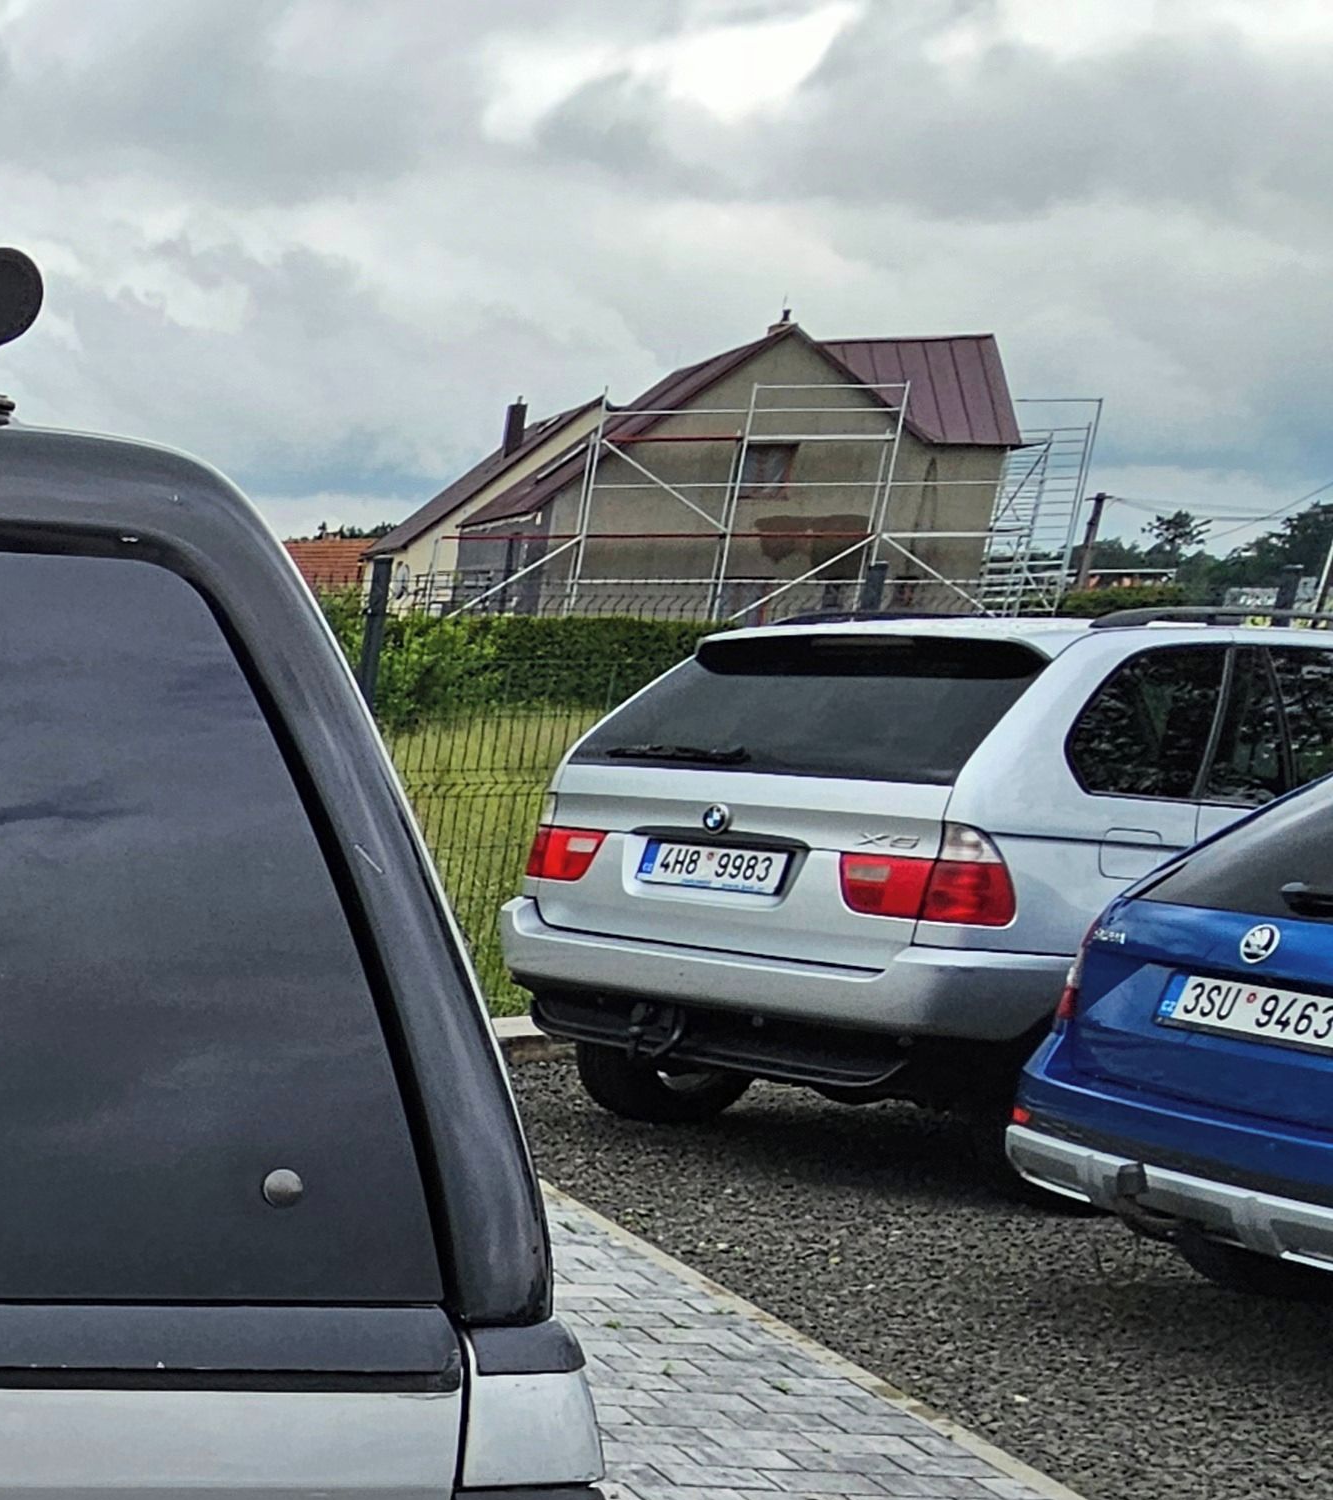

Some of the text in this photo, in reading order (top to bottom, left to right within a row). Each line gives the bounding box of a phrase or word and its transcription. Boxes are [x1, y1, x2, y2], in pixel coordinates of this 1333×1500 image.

[660, 847, 773, 882] 4H8 9983
[1183, 982, 1333, 1039] 3SU 9463
